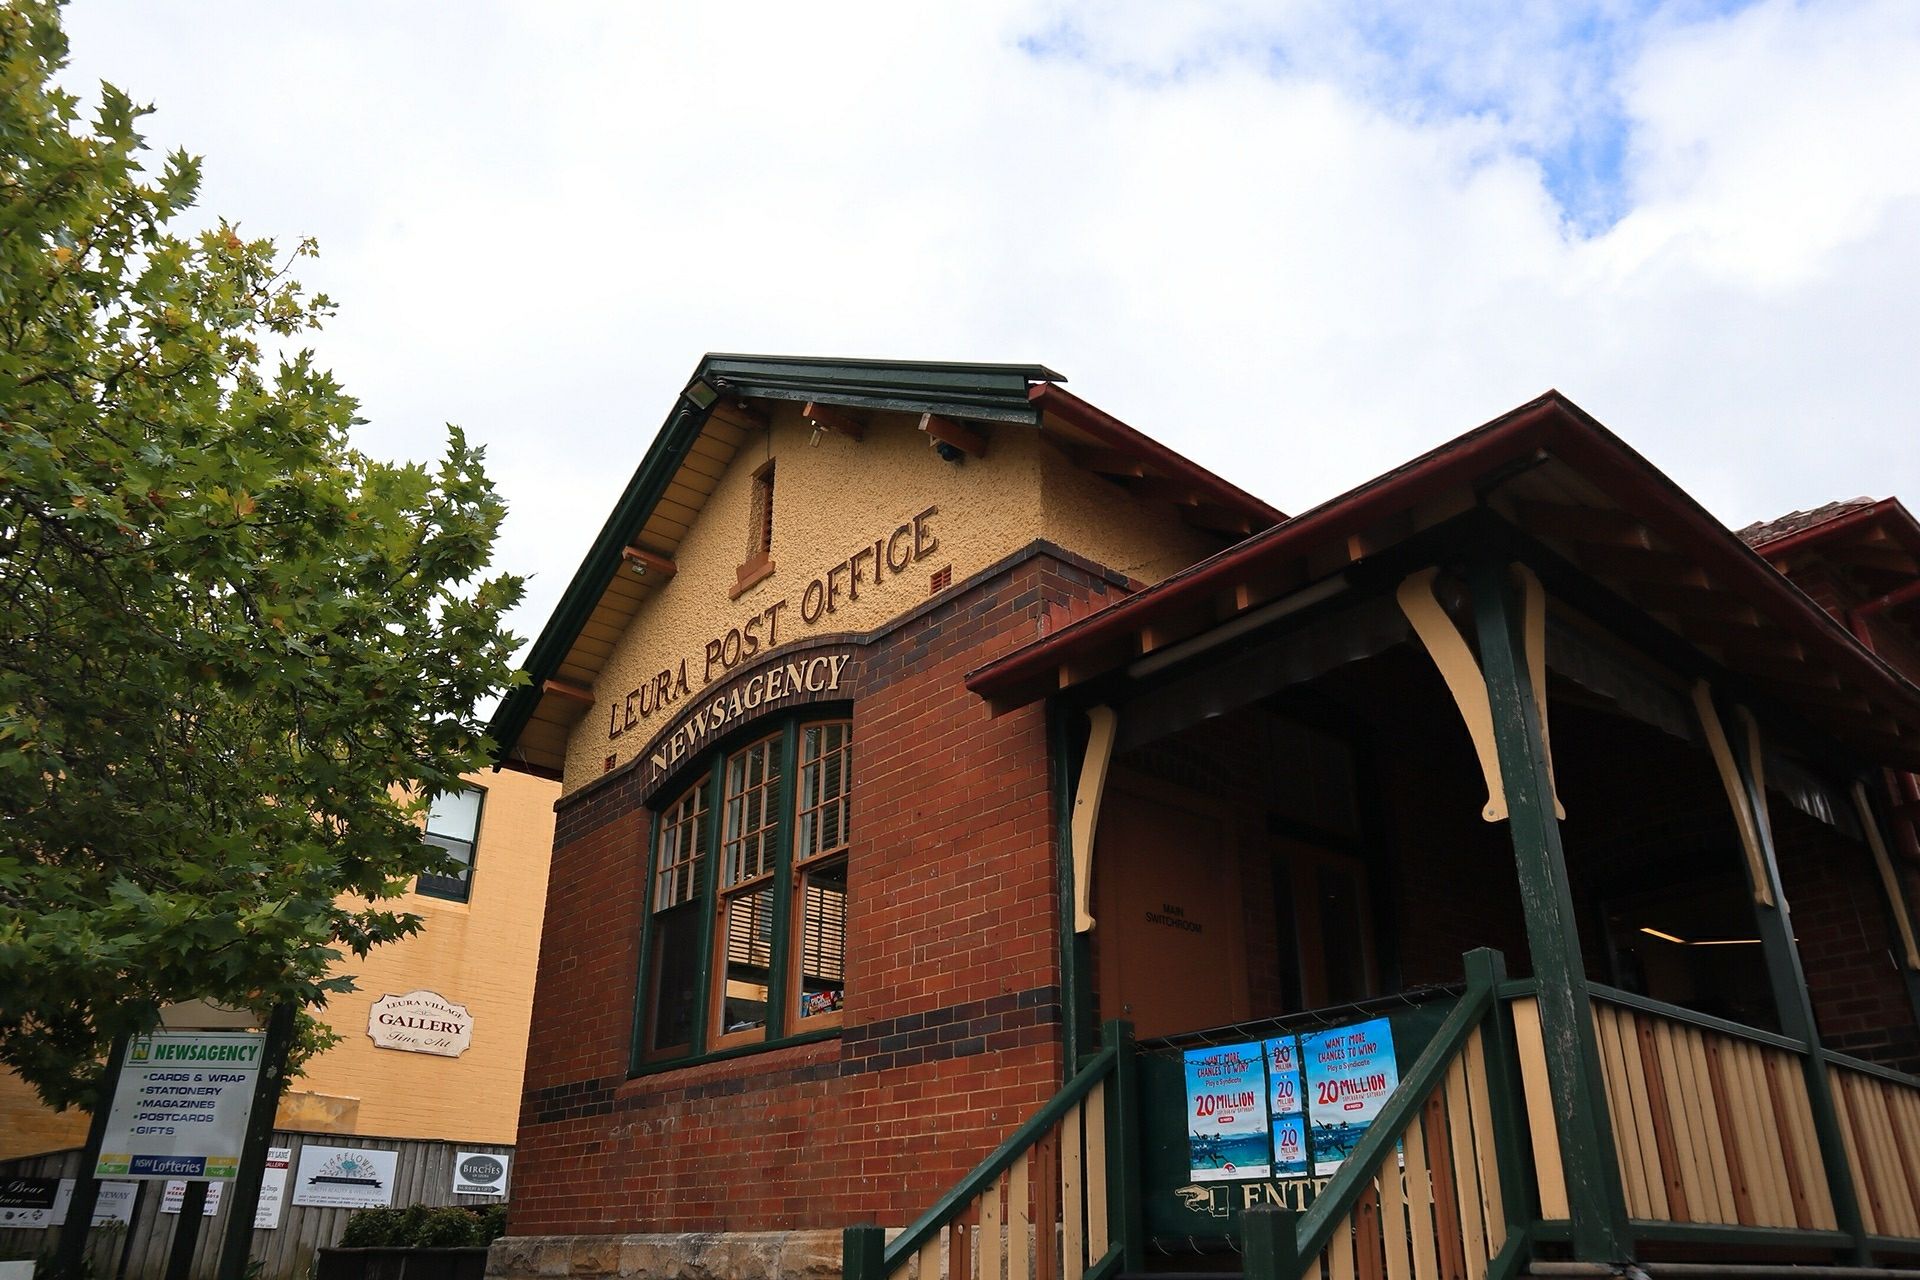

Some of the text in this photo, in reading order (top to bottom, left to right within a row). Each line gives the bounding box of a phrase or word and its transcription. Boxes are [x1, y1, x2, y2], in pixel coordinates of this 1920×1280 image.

[608, 505, 940, 739] LEURA POST OFFICE
[651, 654, 850, 783] NEWSAGENCY
[386, 1000, 464, 1019] LEURA VILLAGE
[379, 1013, 465, 1034] GALLERY
[387, 1031, 451, 1048] Fine Art
[1324, 1032, 1366, 1049] WANT MORE
[154, 1044, 258, 1062] NEWSAGENCY
[1318, 1043, 1377, 1063] CHANCES TO WIN?
[1276, 1063, 1292, 1071] MILLION
[1327, 1064, 1338, 1072] Play
[1343, 1059, 1370, 1071] Syndicate
[149, 1073, 246, 1083] CARDS & WRAP
[1340, 1073, 1386, 1095] MILLION
[145, 1086, 222, 1096] STATIONERY
[142, 1099, 216, 1109] MAGAZINES
[1216, 1091, 1254, 1109] MILLION
[1277, 1097, 1295, 1106] MILLION
[139, 1113, 214, 1122] POSTCARDS
[136, 1126, 175, 1135] GIFTS
[1281, 1147, 1299, 1155] MILLION
[135, 1159, 201, 1173] NSW Lotteries
[319, 1152, 376, 1178] STARFLOWER
[463, 1164, 500, 1175] BIRCHES
[99, 1191, 130, 1200] NEWAY
